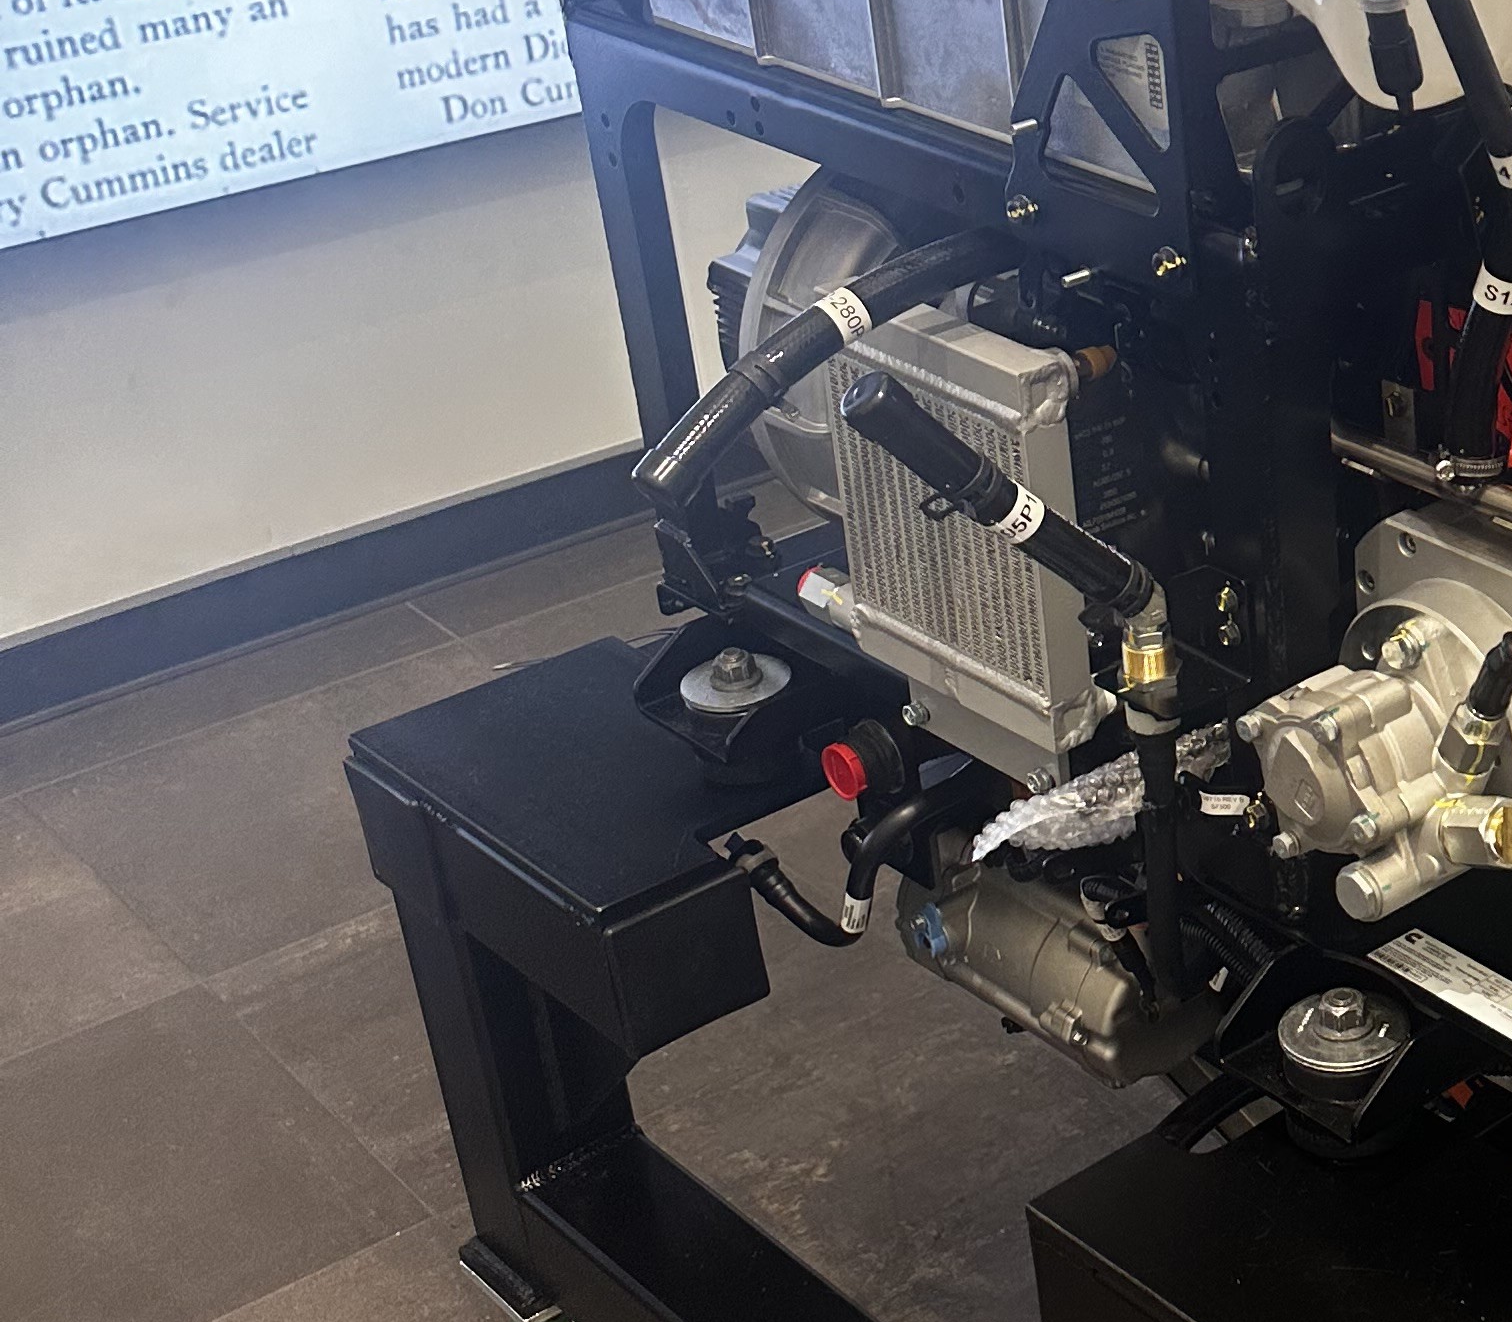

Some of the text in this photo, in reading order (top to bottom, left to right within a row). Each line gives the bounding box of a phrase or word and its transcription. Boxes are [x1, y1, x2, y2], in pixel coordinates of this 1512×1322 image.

[4, 17, 122, 70] ruined
[137, 5, 233, 45] many
[385, 12, 441, 45] has
[397, 48, 512, 89] modern
[3, 74, 142, 122] orphan.
[441, 93, 508, 124] Don
[38, 85, 309, 165] orphan. Service
[40, 129, 317, 210] Cummins dealer
